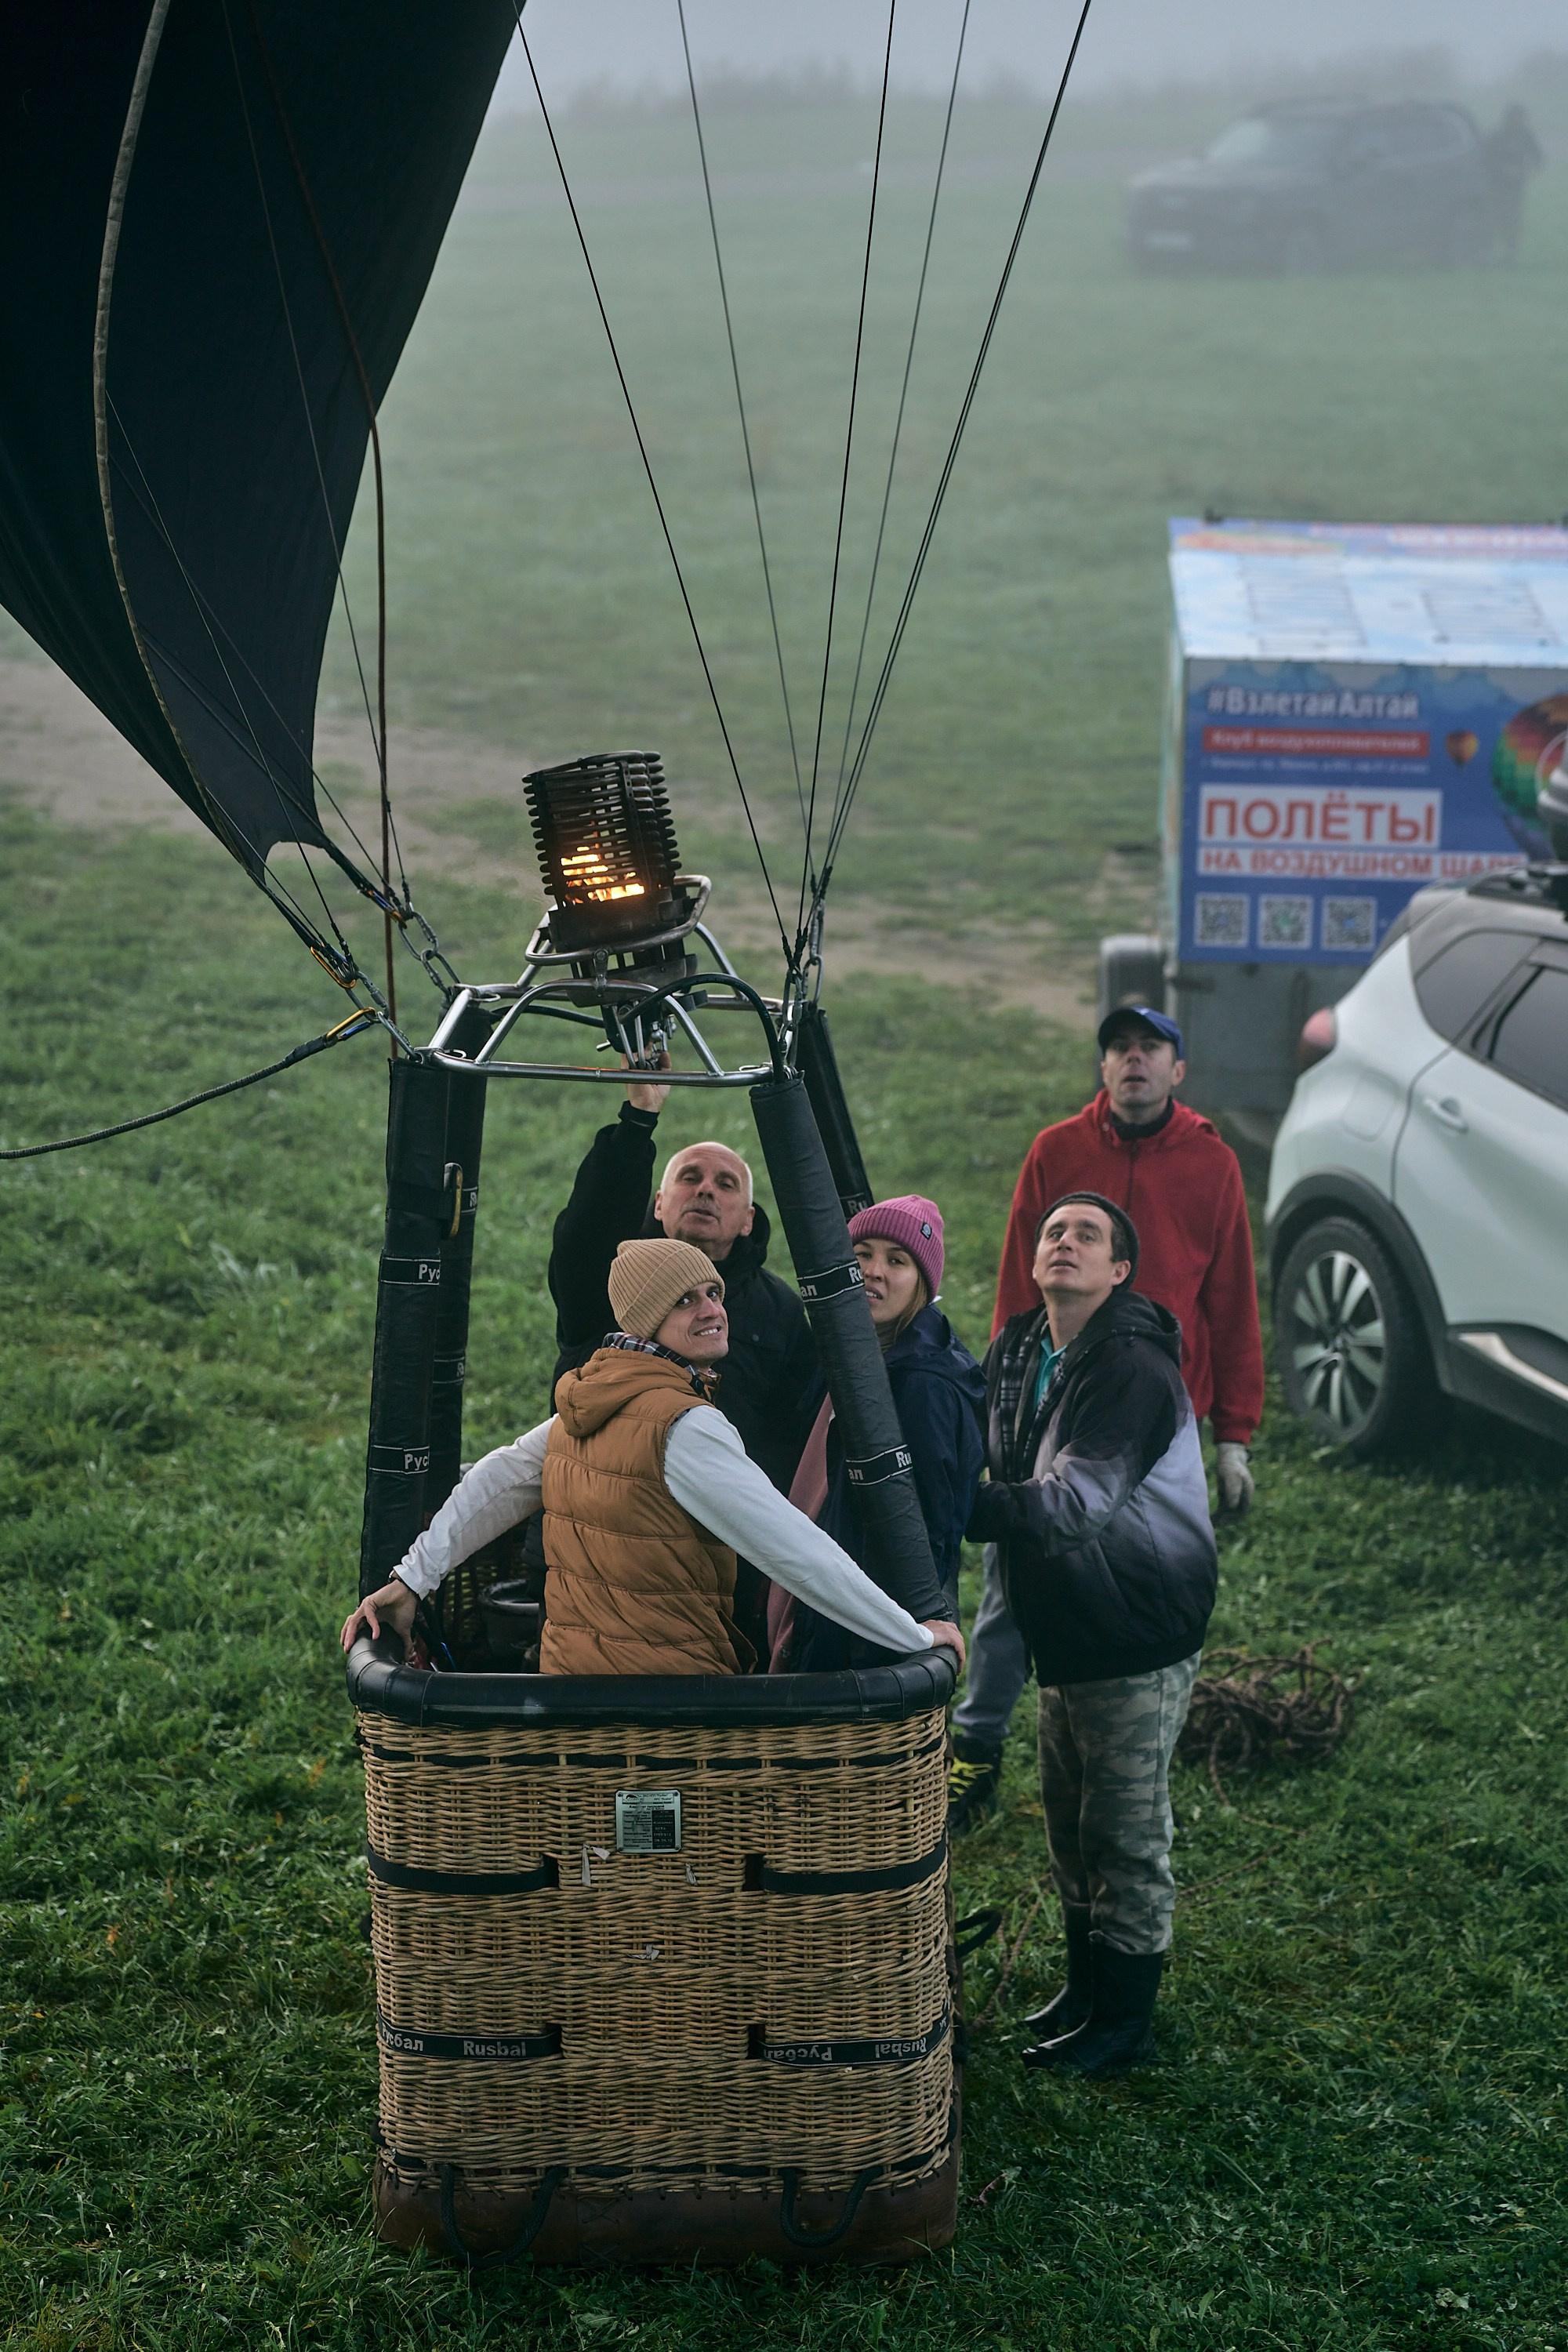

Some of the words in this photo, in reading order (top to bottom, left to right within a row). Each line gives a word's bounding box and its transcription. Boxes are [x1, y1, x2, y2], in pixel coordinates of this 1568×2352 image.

[1207, 687, 1419, 718] #ВзлетайАлтай
[1205, 793, 1436, 844] ПОЛЁТЫ
[1203, 851, 1243, 871] НА
[1250, 852, 1432, 878] ВОЗДУШНОМ
[382, 2022, 424, 2052] Русбал
[463, 2040, 526, 2056] Rusbal
[764, 2045, 833, 2061] Русбал
[875, 2037, 927, 2058] Rusbal
